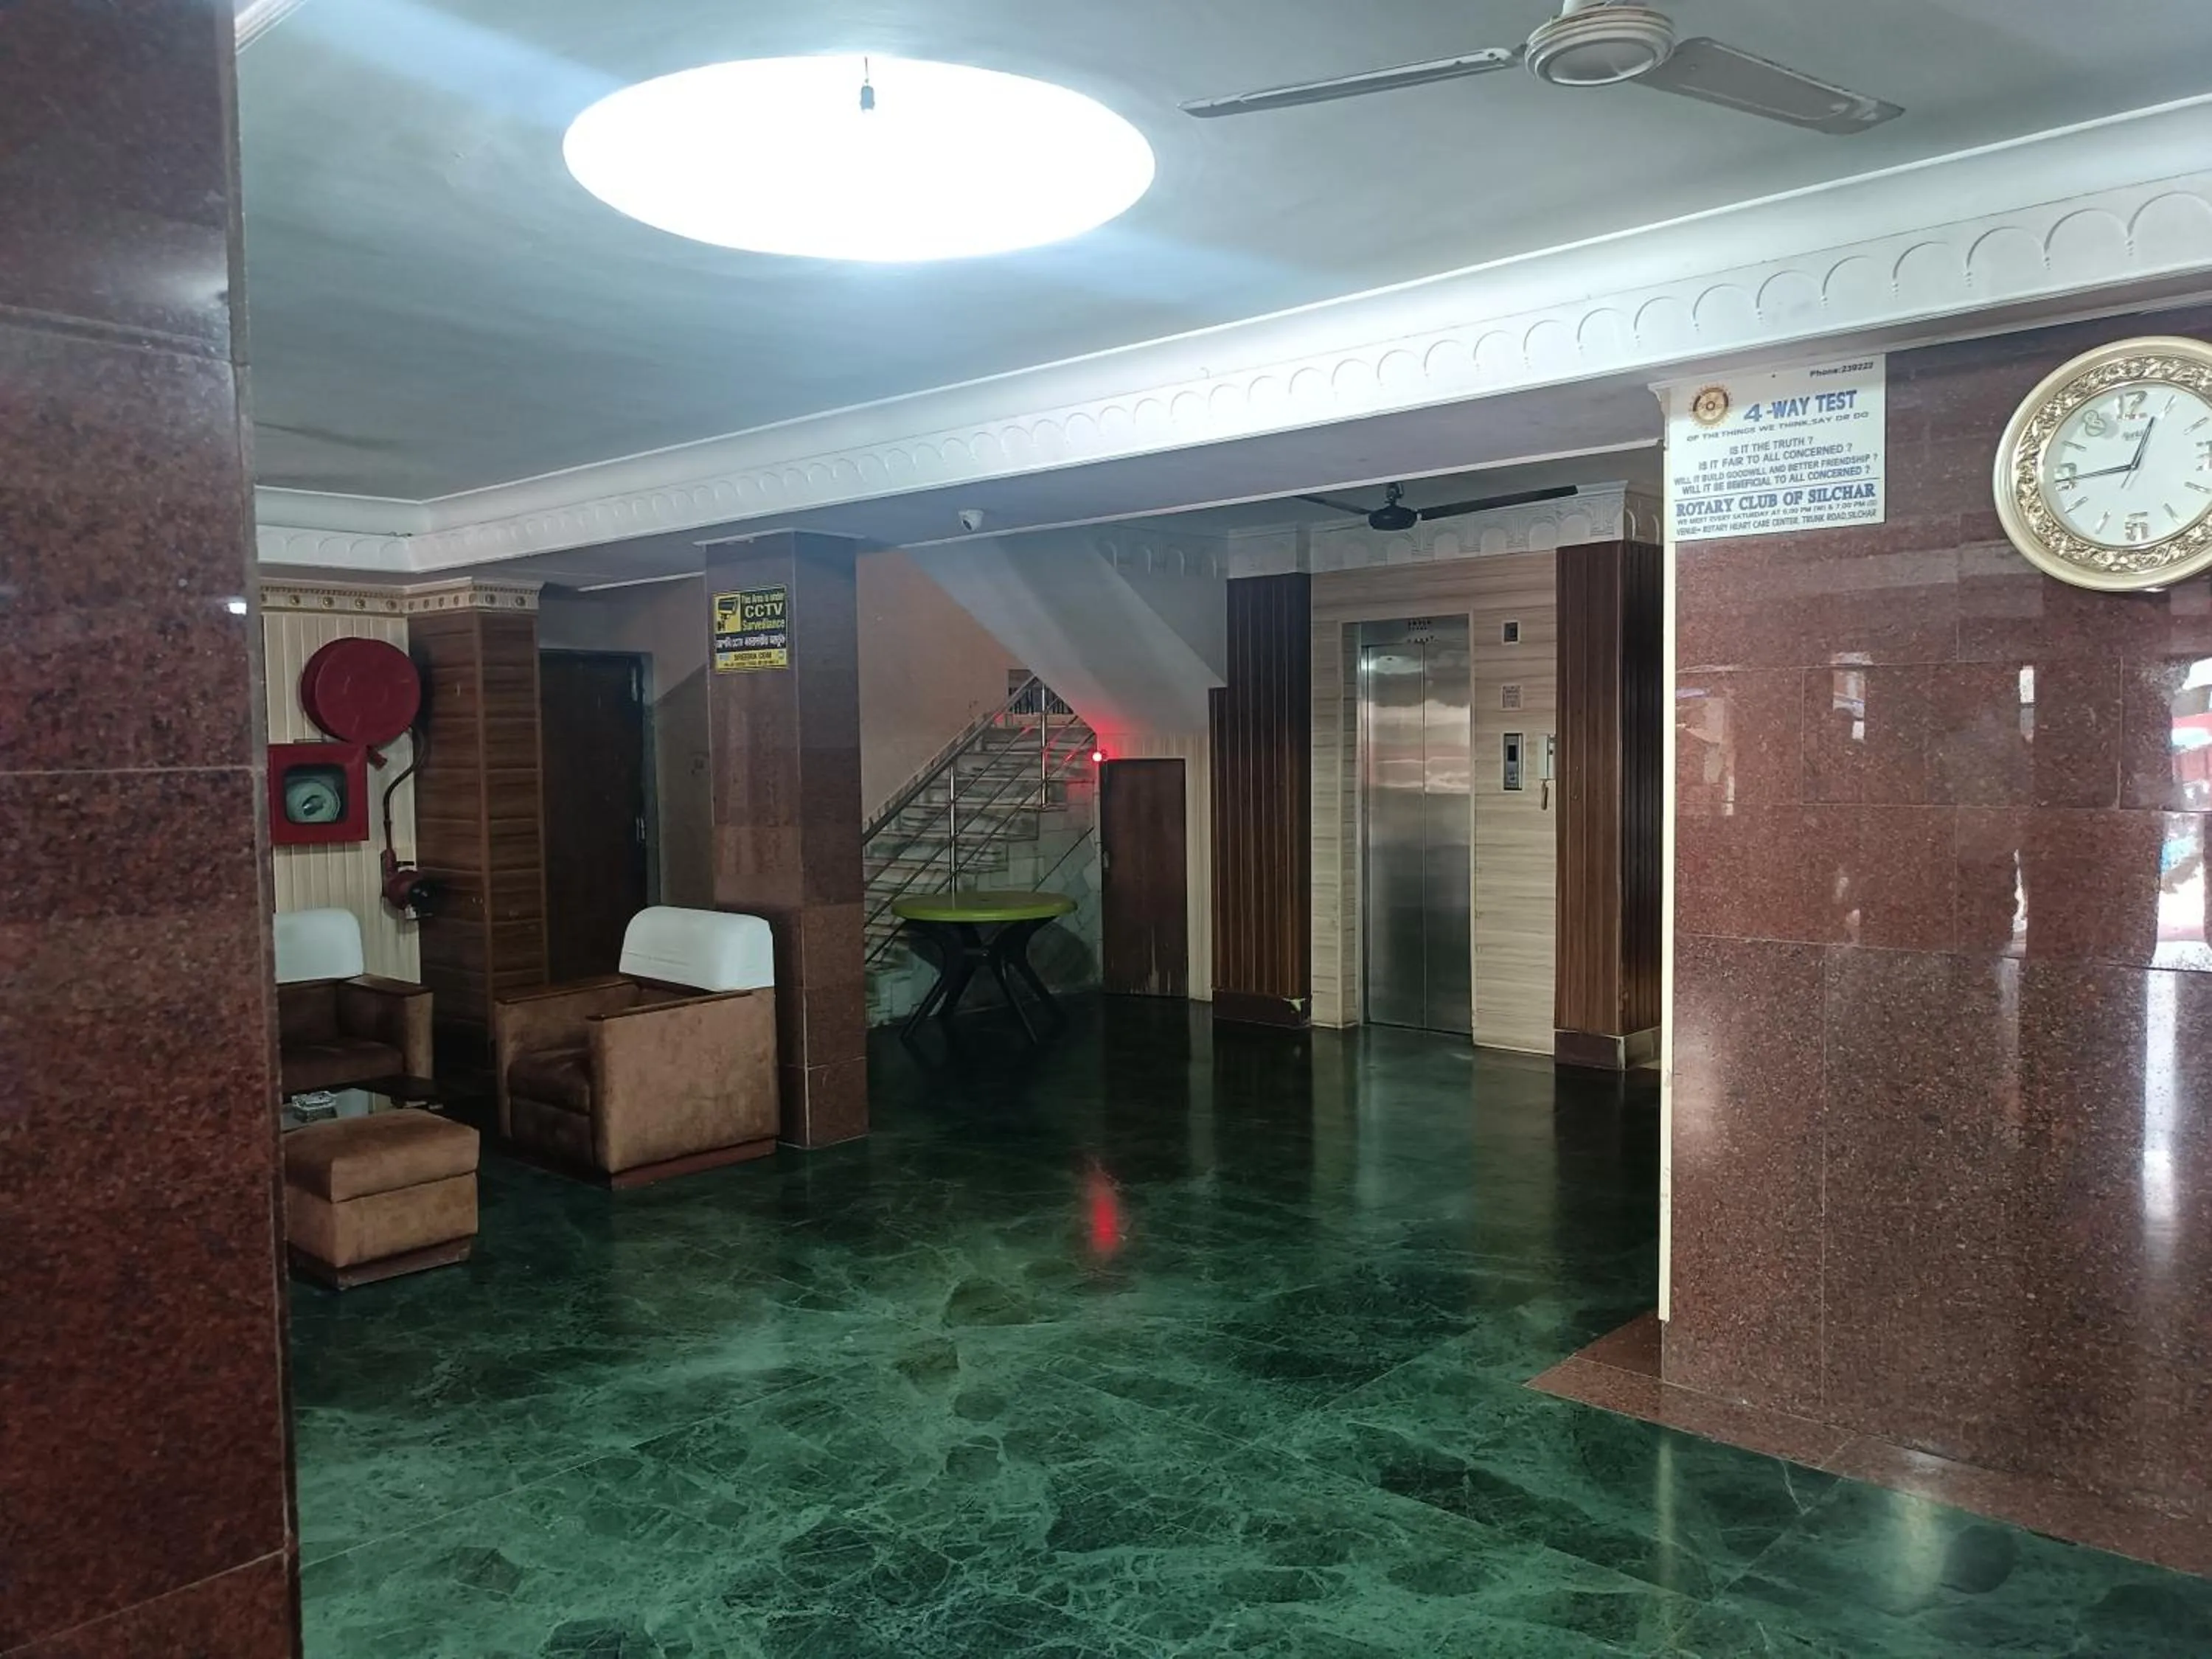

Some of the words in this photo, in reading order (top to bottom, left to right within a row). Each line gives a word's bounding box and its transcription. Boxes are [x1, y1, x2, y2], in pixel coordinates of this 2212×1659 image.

[1815, 389, 1857, 413] TEST
[1722, 427, 1756, 437] THINGS
[1853, 411, 1869, 420] DO
[1698, 461, 1708, 470] IS
[1710, 459, 1719, 470] IT
[1722, 456, 1744, 467] FAIR
[1747, 454, 1760, 465] TO
[1763, 452, 1781, 462] ALL
[1783, 444, 1844, 460] CONCERNED
[1729, 445, 1739, 455] IS
[1741, 444, 1749, 453] IT
[1752, 440, 1770, 452] THE
[1773, 437, 1805, 450] TRUTH
[1674, 476, 1691, 486] WILL
[1694, 474, 1700, 483] IT
[1702, 472, 1725, 482] BUILD
[1726, 467, 1767, 479] GOODWILL
[1770, 465, 1786, 474] AND
[1788, 460, 1819, 472] BETTER
[1821, 453, 1871, 468] FRIENDSHIP
[1682, 485, 1701, 495] WILL
[1703, 484, 1711, 493] IT
[1713, 481, 1725, 492] BE
[1726, 476, 1771, 490] BENEFICIAL
[1774, 474, 1787, 484] TO
[1789, 472, 1805, 482] ALL
[1807, 465, 1863, 480] CONCERNED
[1676, 498, 1734, 517] ROTARY
[1739, 493, 1778, 510] CLUB
[1783, 490, 1803, 506] OF
[1807, 483, 1876, 503] SILCHAR
[1703, 523, 1728, 533] ROTARY
[1730, 520, 1752, 530] HEART
[1753, 518, 1770, 529] CARE
[1801, 512, 1825, 524] TRUNK
[745, 602, 783, 618] CCTV
